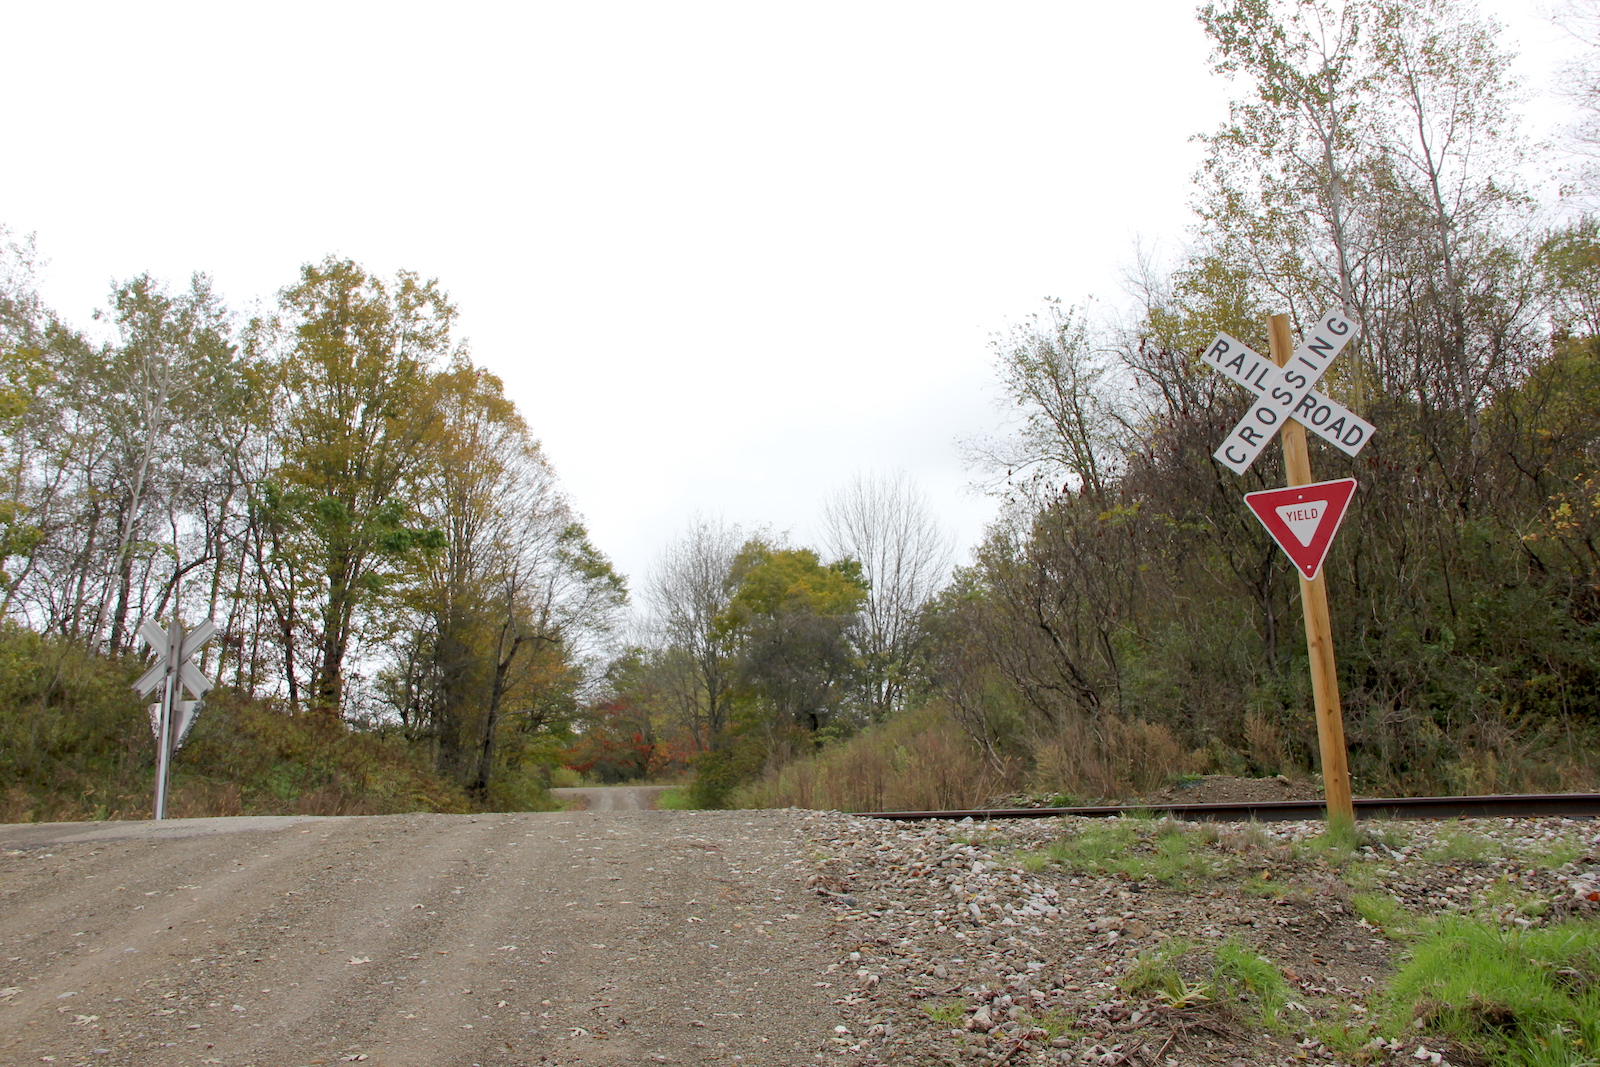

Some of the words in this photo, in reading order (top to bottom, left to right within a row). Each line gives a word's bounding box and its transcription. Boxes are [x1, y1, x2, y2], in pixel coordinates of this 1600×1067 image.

[1207, 339, 1269, 391] RAIL
[1294, 394, 1364, 447] ROAD
[1225, 317, 1349, 464] CROSSING
[1286, 508, 1318, 522] YIELD
